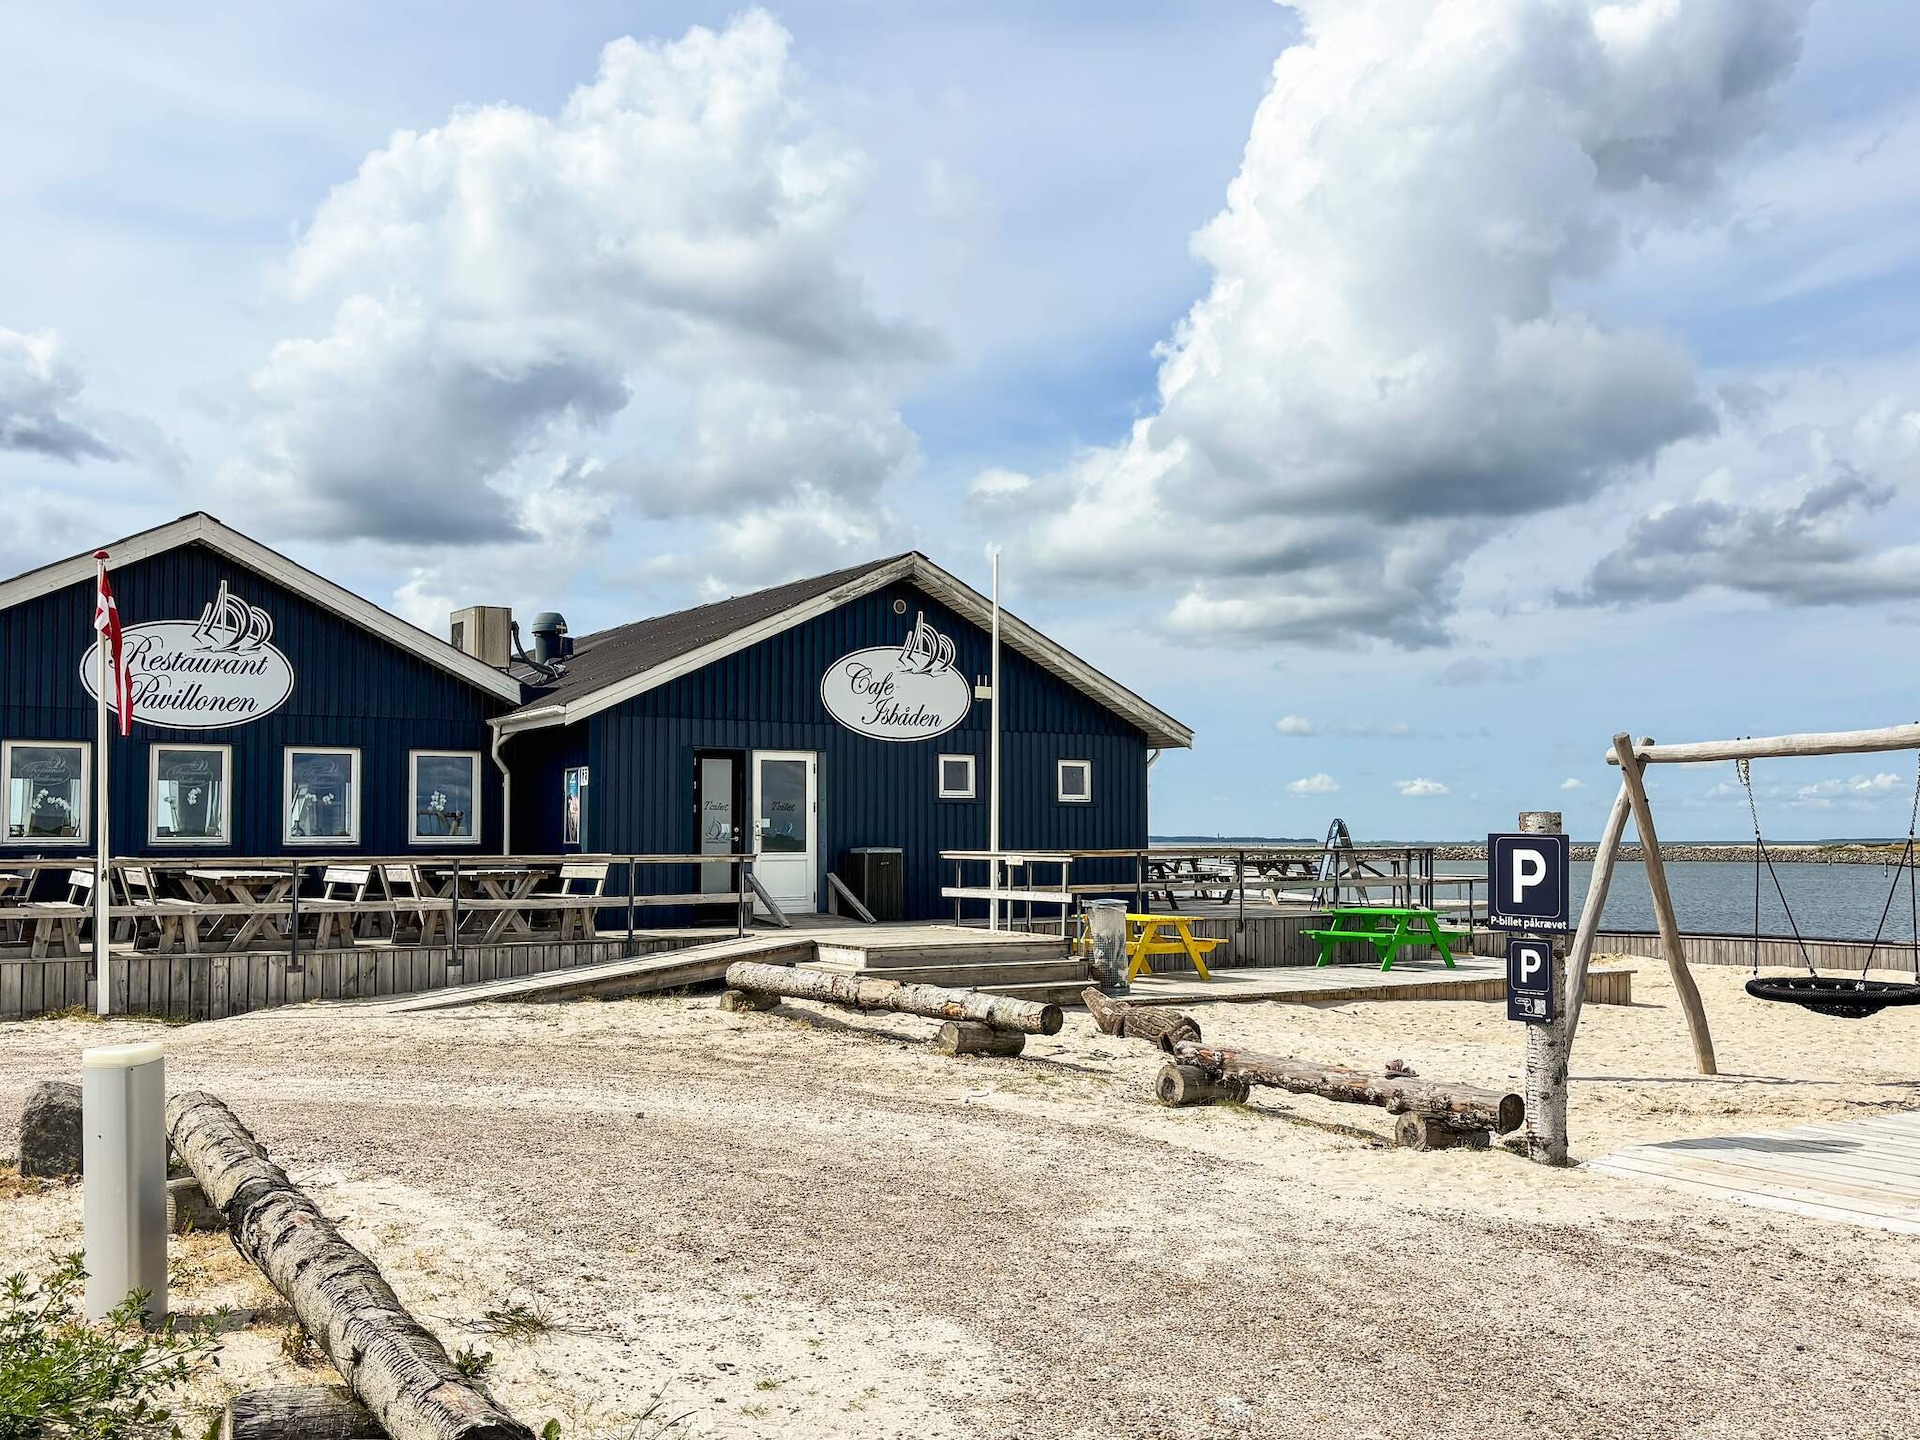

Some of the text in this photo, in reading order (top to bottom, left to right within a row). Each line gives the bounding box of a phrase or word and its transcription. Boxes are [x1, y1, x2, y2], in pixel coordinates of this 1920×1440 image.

[109, 633, 268, 676] Restaurant
[131, 673, 259, 712] Pavillonen
[845, 662, 895, 704] Cafe
[861, 696, 942, 727] Isbåden
[1512, 848, 1547, 904] P
[1490, 915, 1567, 930] P-billet påkrævet
[1520, 948, 1542, 984] P
